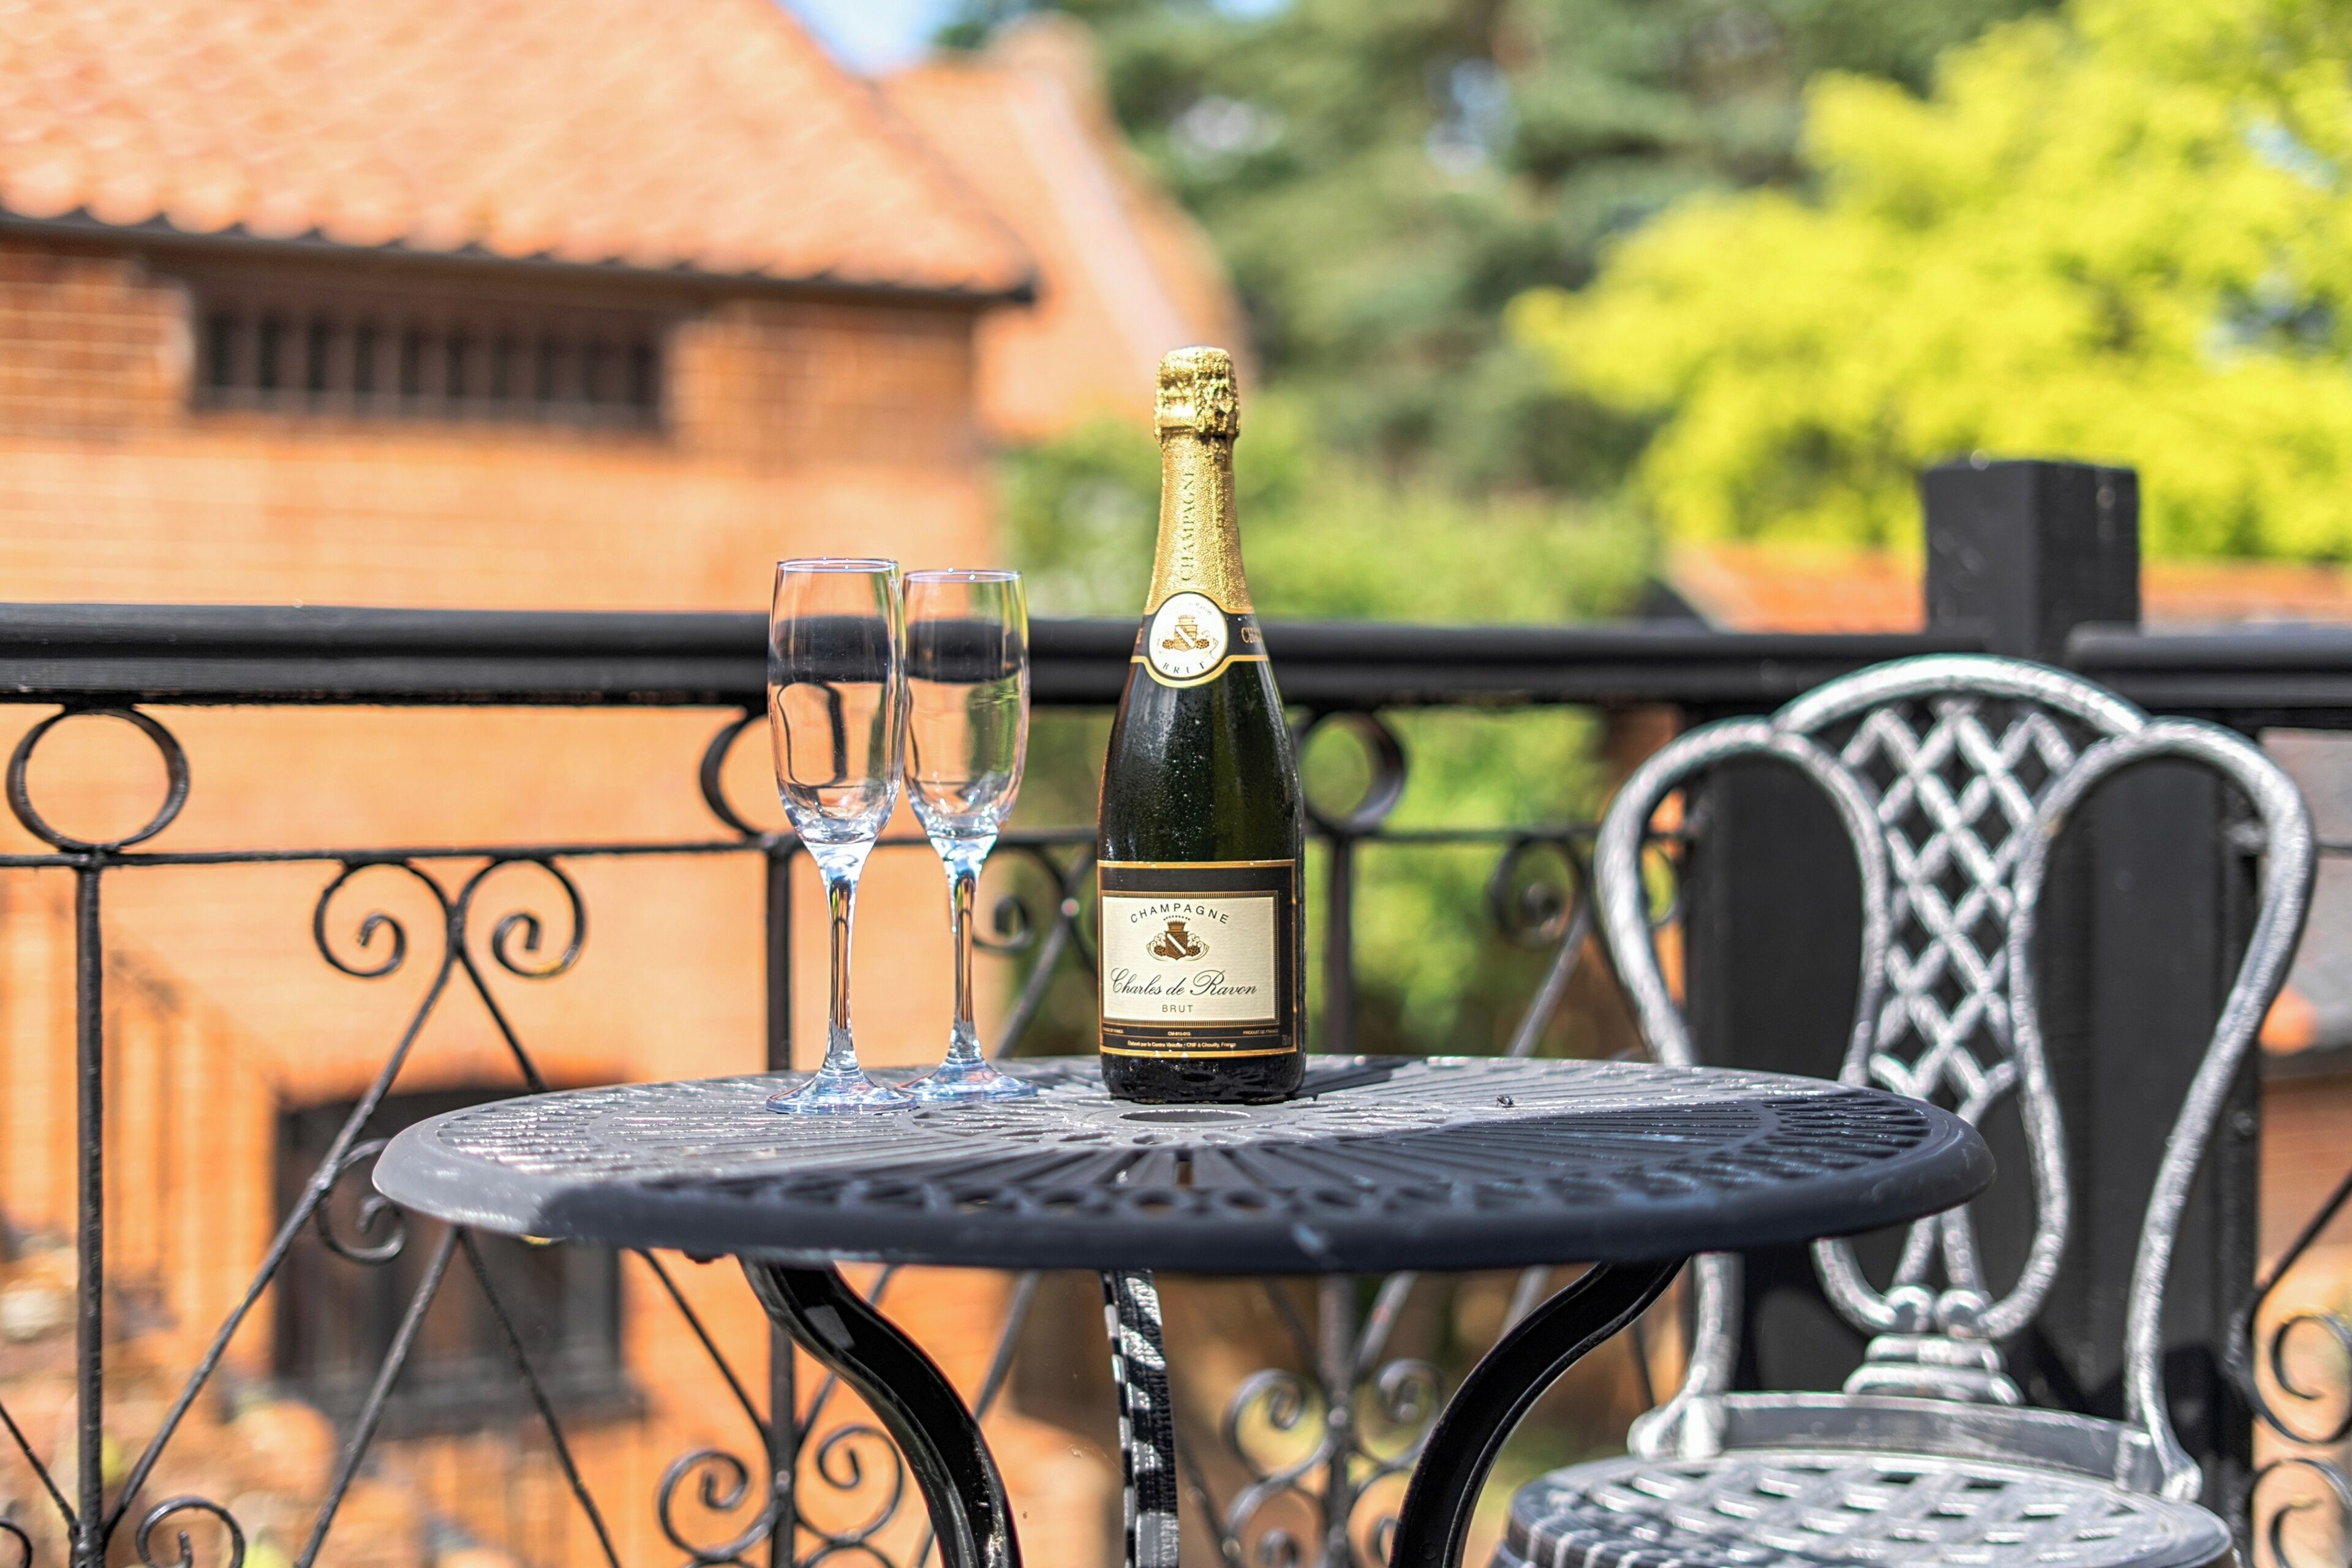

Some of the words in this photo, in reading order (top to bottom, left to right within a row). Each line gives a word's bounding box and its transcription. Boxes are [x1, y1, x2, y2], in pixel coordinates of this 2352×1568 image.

[1130, 903, 1229, 924] CHAMPAGNE
[1110, 967, 1162, 995] Charles
[1166, 977, 1186, 995] de
[1190, 970, 1257, 995] Ravon
